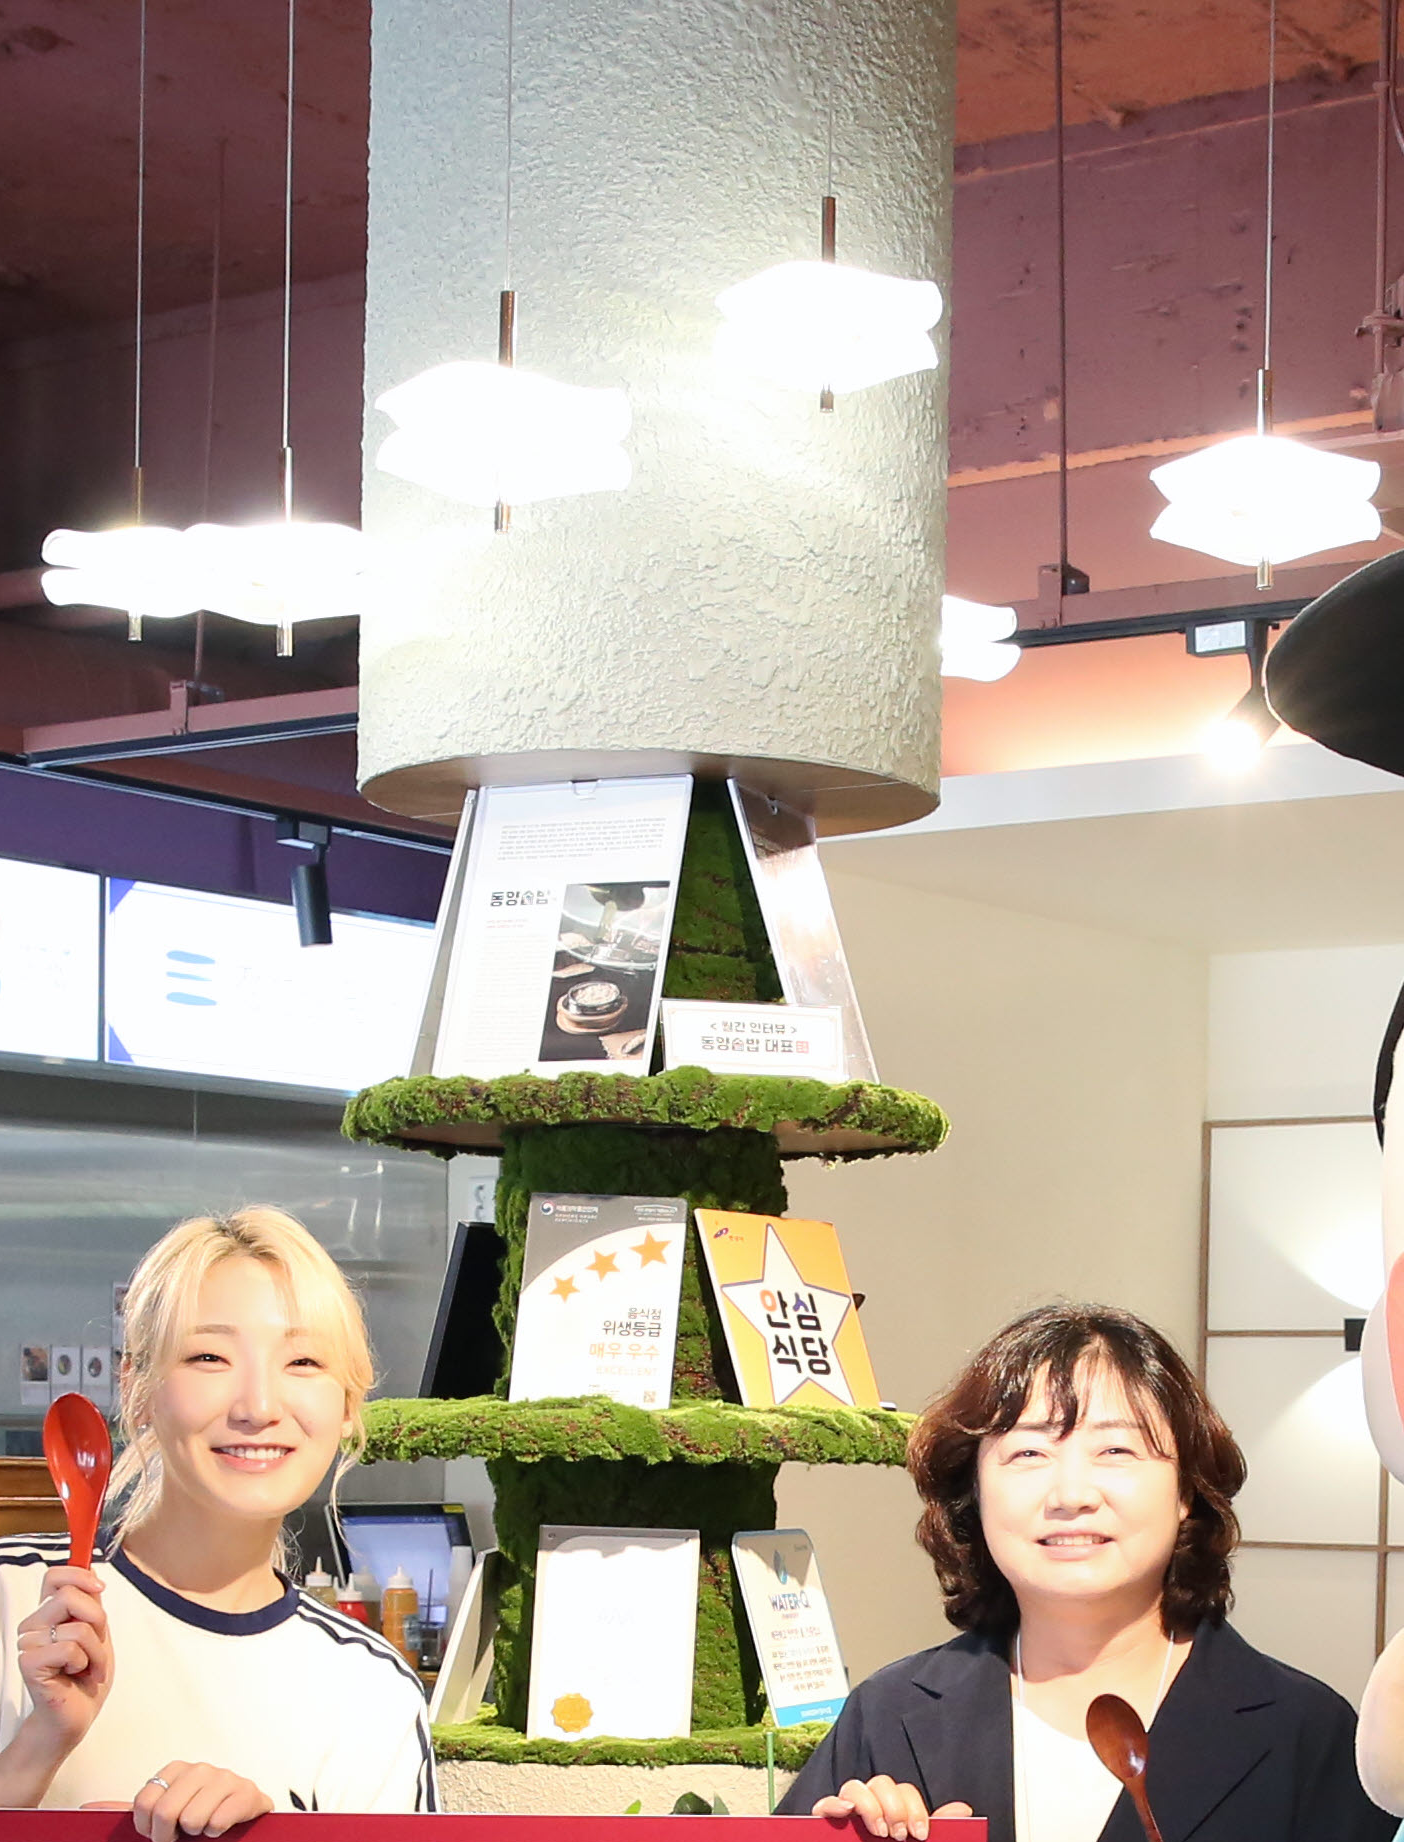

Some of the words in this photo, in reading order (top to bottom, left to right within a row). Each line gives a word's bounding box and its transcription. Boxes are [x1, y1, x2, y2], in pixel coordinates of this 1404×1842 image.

[750, 1022, 786, 1034] 인터뷰
[701, 1036, 760, 1052] 동양솥밥
[765, 1038, 794, 1053] 대표
[628, 1307, 662, 1320] 음식점
[760, 1289, 822, 1331] 안심
[602, 1320, 662, 1337] 위생등급
[589, 1342, 622, 1359] 매우
[626, 1343, 660, 1360] 우수
[772, 1334, 831, 1375] 식당
